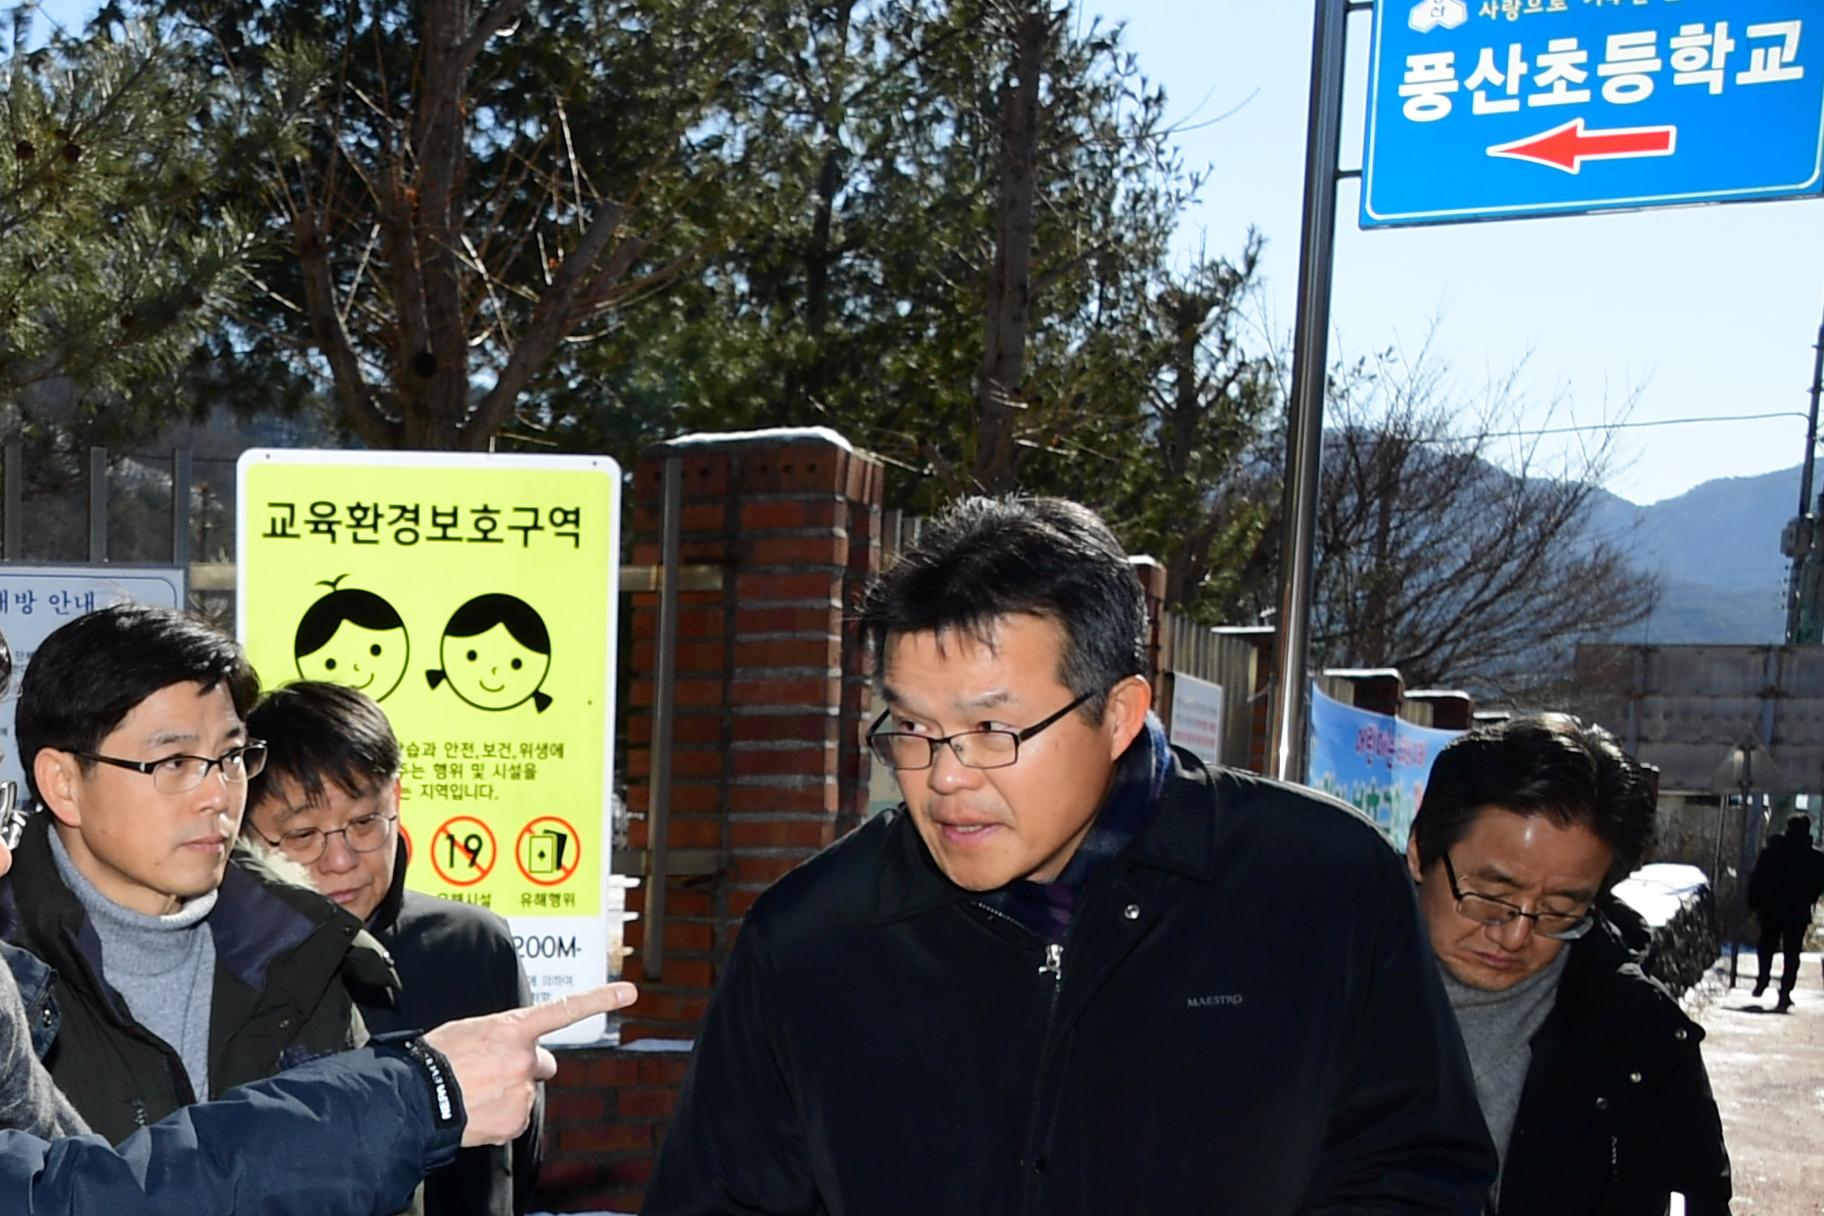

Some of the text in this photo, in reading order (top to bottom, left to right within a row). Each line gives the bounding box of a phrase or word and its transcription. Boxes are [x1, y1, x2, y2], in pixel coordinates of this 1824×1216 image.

[1398, 19, 1805, 122] 풍산초등학교
[262, 501, 581, 548] 교육환경보호구역
[48, 590, 95, 616] 안내
[433, 763, 463, 780] 행위
[471, 763, 485, 780] 및
[493, 763, 537, 780] 시설을
[420, 784, 499, 801] 지역입니다.
[444, 834, 483, 869] 19
[521, 892, 576, 908] 유해행위
[1187, 993, 1243, 1008] MAESTRO
